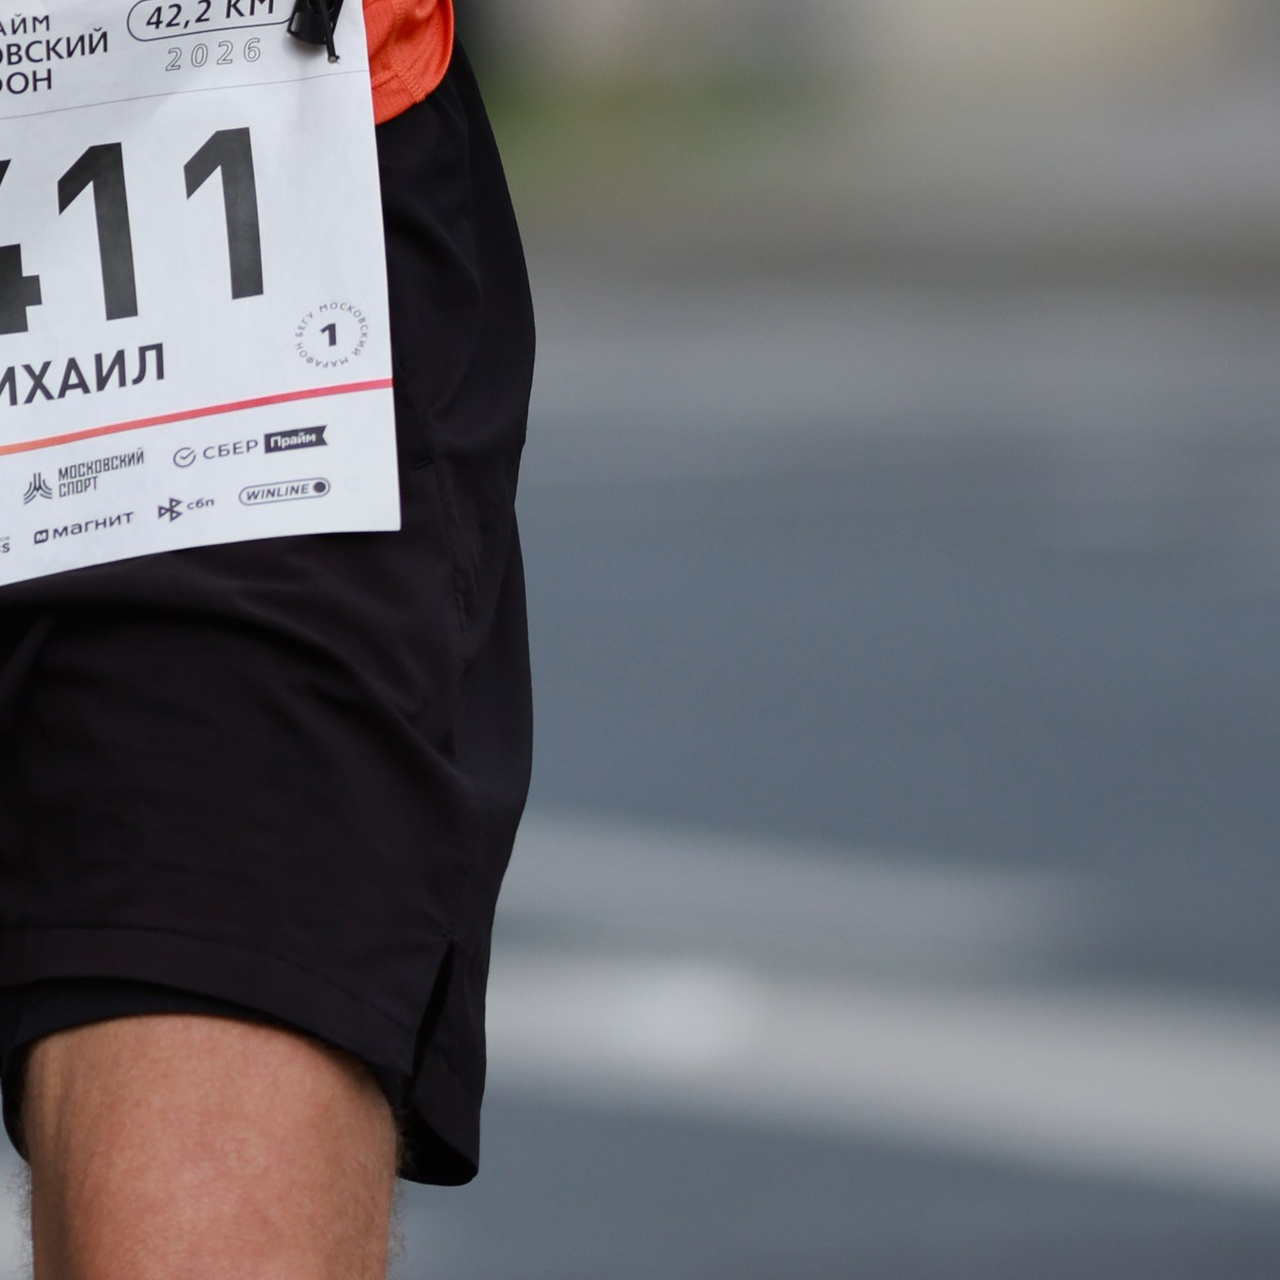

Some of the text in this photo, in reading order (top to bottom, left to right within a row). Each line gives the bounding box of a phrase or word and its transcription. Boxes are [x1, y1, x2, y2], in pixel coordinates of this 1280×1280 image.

[165, 37, 261, 71] 2026
[318, 301, 369, 357] МОСКОВСКИЙ
[319, 322, 337, 347] 1
[295, 341, 349, 369] МАРАФОН
[202, 431, 318, 460] СБЕР Прайм
[58, 447, 145, 482] МОСКОВСКИЙ
[58, 476, 98, 498] СПОРТ
[245, 483, 310, 502] WINLINE
